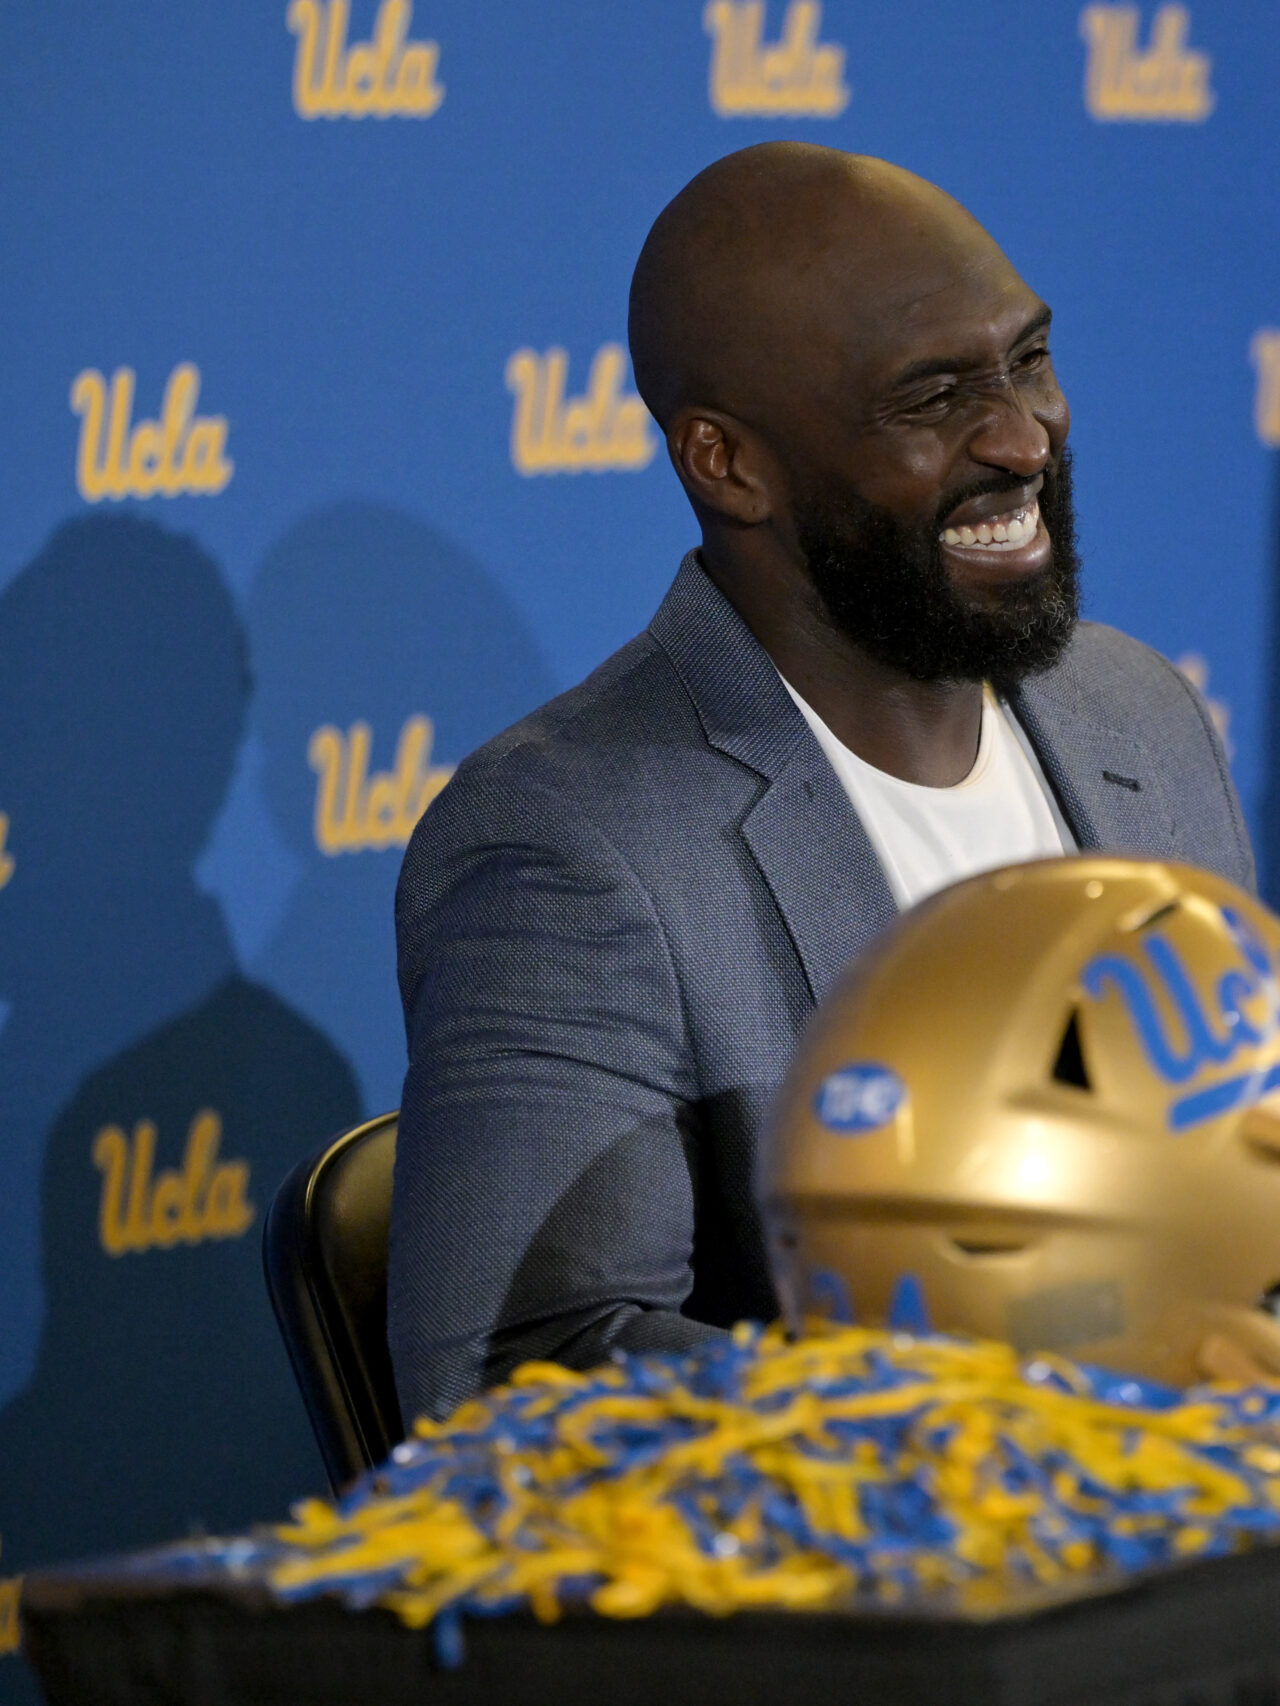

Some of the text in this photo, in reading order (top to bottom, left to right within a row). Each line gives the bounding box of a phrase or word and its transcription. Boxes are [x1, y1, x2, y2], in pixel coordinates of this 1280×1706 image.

[288, 0, 443, 118] Ucla
[704, 0, 848, 117] Ucla
[72, 363, 232, 501] Ucla
[507, 344, 657, 476] Ucla
[92, 1108, 256, 1258] Ucla
